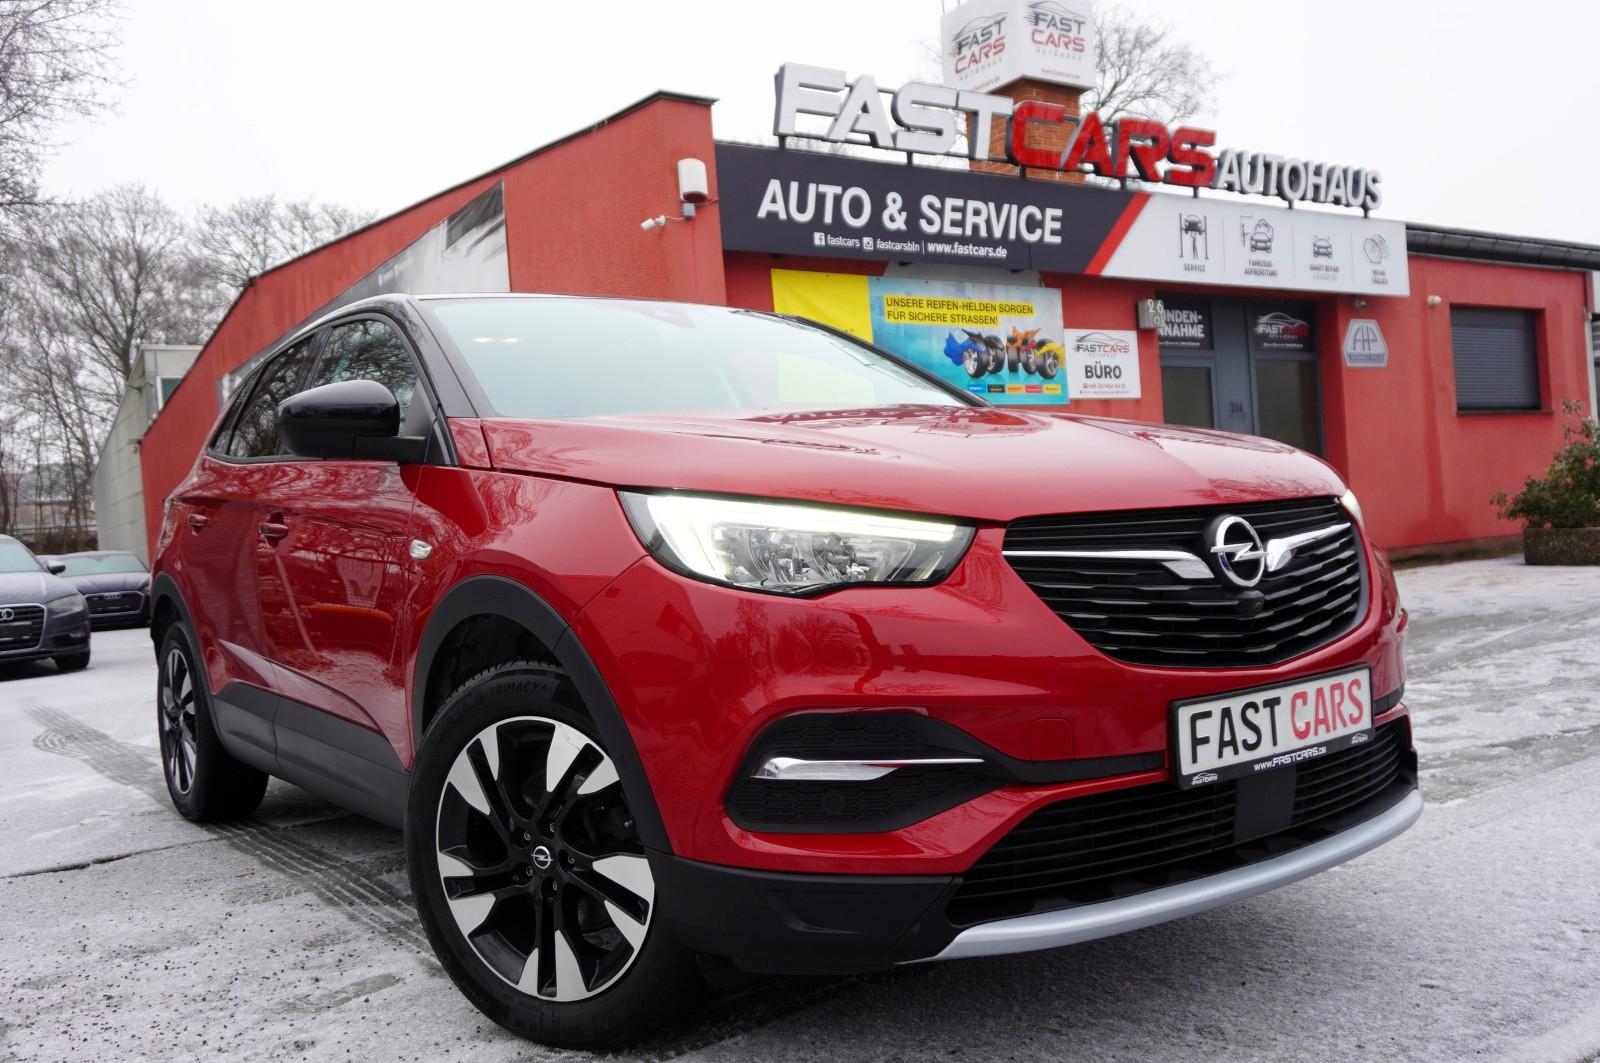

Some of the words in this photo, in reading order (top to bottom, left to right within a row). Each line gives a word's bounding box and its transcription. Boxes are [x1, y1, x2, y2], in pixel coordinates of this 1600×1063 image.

[1032, 11, 1086, 35] FAST
[956, 16, 1007, 56] FAST
[1031, 28, 1085, 53] CARS
[955, 36, 1006, 74] CARS
[1211, 147, 1383, 210] AUTOHAUS
[757, 178, 872, 228] AUTO
[881, 191, 908, 231] &
[919, 194, 1064, 244] SERVICE
[827, 234, 861, 248] fastcars
[927, 242, 1008, 258] www.fastcars.de
[1183, 263, 1206, 273] SERVICE
[886, 297, 924, 309] UNSERE
[926, 300, 997, 313] REIFEN-HELDEN
[998, 304, 1034, 315] SORGEN
[887, 309, 906, 320] FÜR
[908, 312, 948, 323] SICHERE
[950, 314, 999, 325] STRASSEN!
[1147, 298, 1164, 314] 26
[1074, 344, 1130, 354] FASTCARS
[1084, 360, 1122, 380] BÜRO
[488, 681, 540, 696] PRIMACY
[1189, 696, 1282, 765] FAST
[1291, 678, 1364, 740] CARS
[1253, 746, 1328, 772] www.FASTCARS.DE
